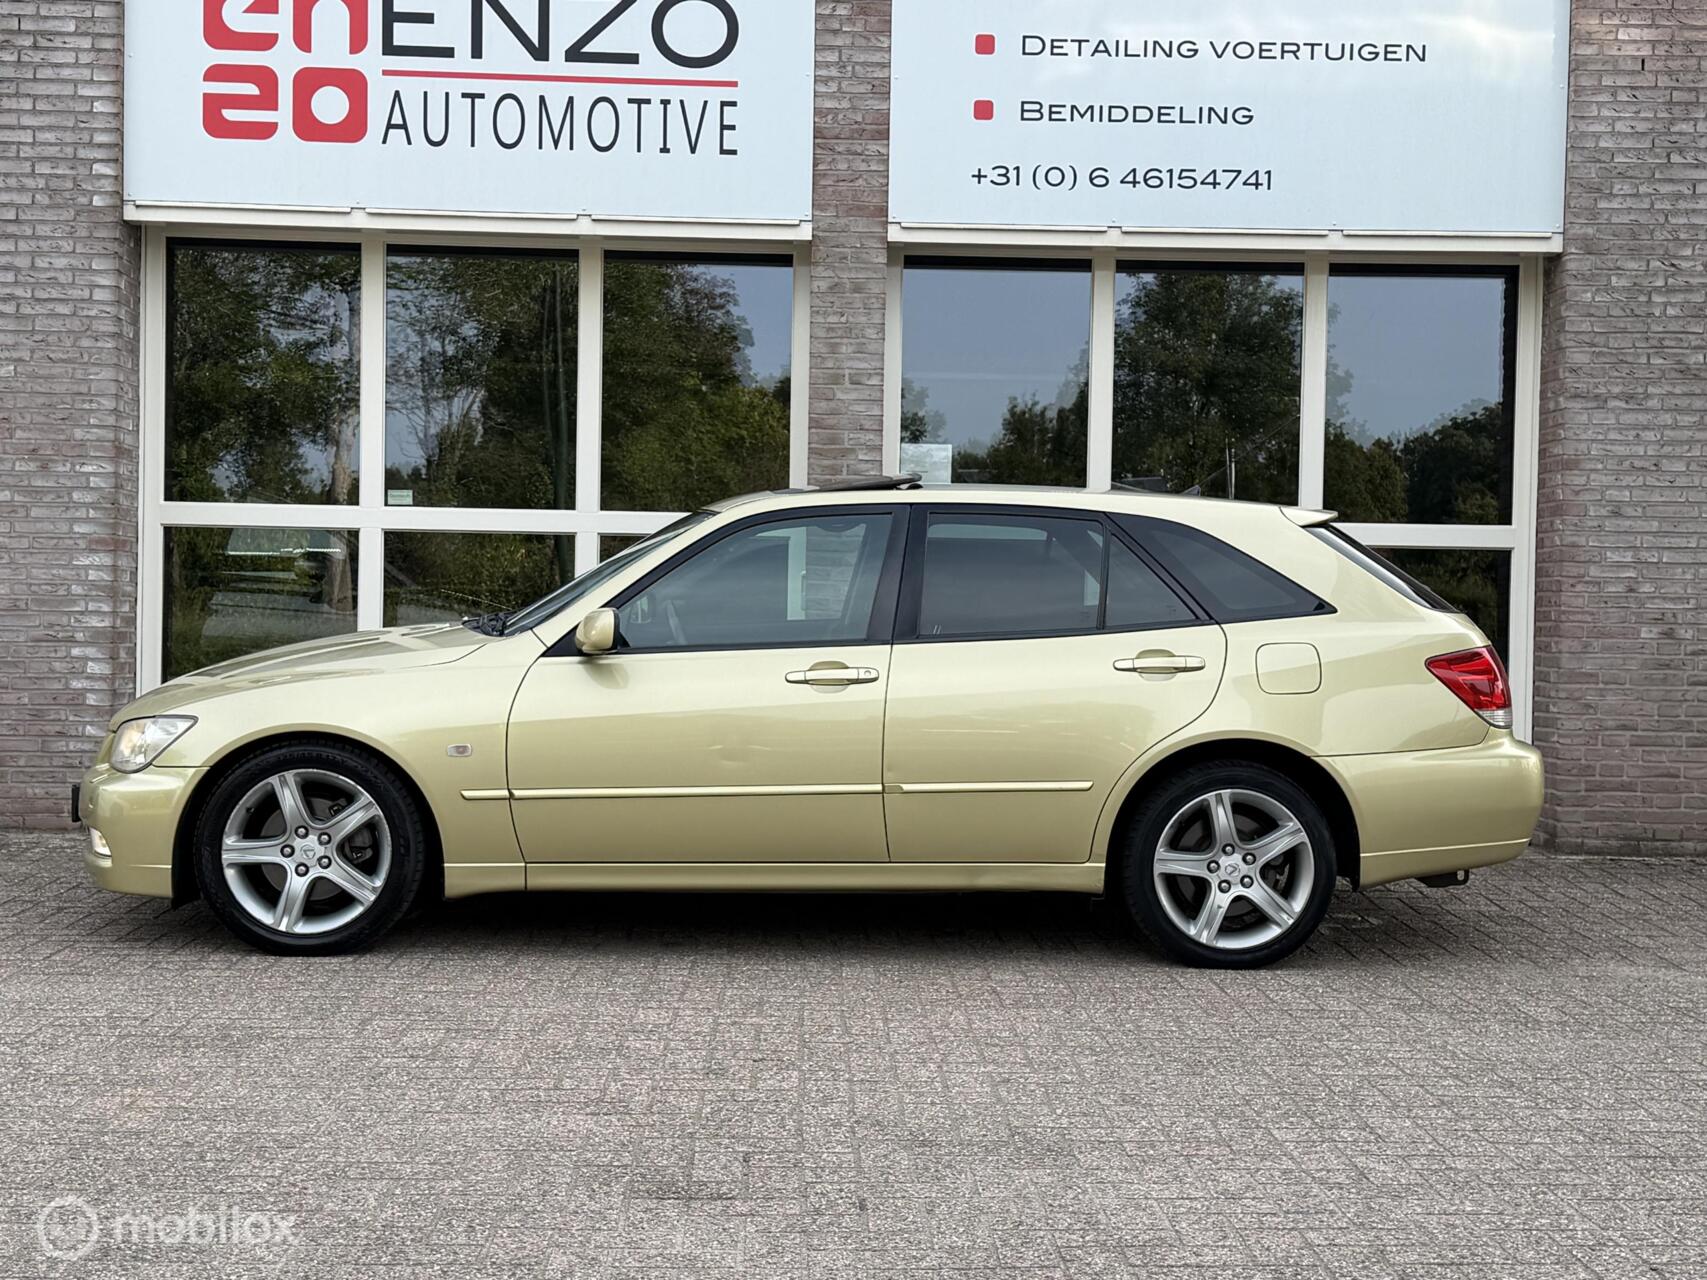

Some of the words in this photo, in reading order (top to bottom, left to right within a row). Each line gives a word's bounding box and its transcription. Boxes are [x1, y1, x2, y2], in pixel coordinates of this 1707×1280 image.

[381, 0, 740, 69] ENZO
[1021, 35, 1199, 59] DETAILING
[1209, 40, 1427, 63] VOERTUIGEN
[381, 89, 739, 156] AUTOMOTIVE
[1020, 100, 1254, 126] BEMIDDELING
[971, 165, 1021, 187] +31
[1032, 164, 1078, 191] (0)
[1088, 166, 1110, 188] 6
[1119, 167, 1272, 191] 46154741
